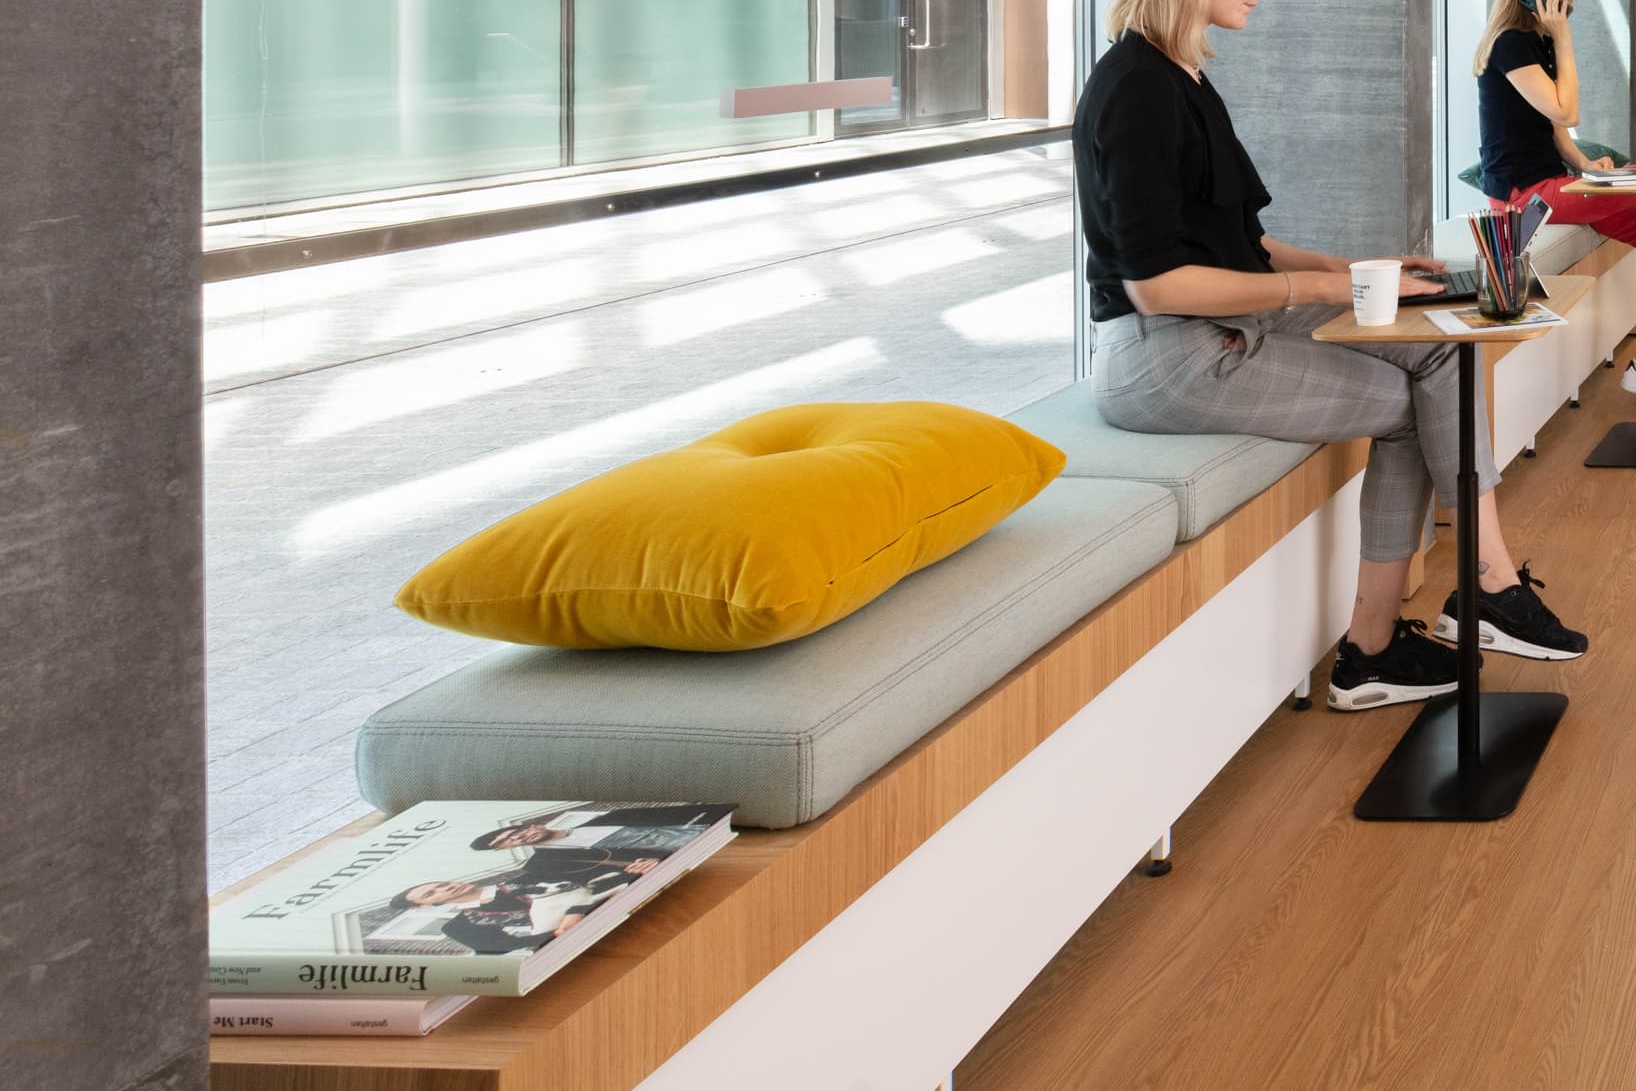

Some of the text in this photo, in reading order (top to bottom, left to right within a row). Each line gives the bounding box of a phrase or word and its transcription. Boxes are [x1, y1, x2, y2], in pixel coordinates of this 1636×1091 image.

[240, 818, 448, 920] Farmlife
[298, 964, 429, 991] Farmlife
[213, 1016, 235, 1028] Me
[239, 1016, 274, 1029] Start
